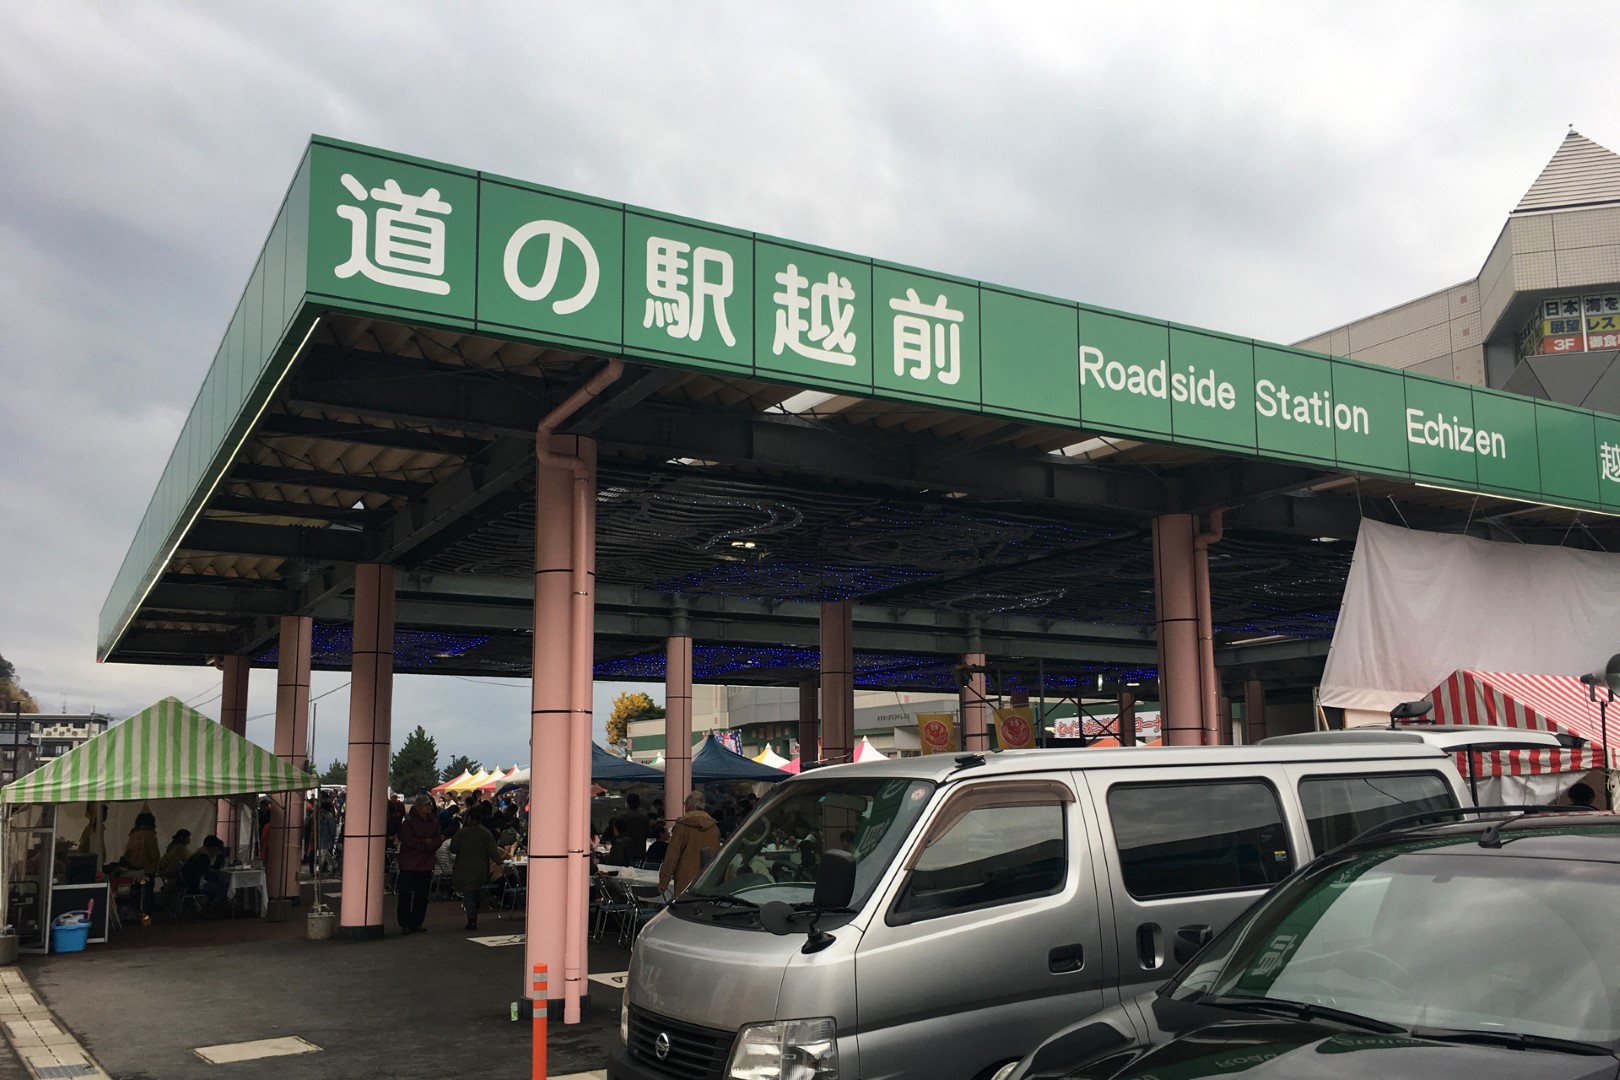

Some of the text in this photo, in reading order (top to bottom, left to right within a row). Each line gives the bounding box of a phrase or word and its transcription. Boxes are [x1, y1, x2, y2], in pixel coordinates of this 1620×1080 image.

[333, 173, 965, 386] 道の駅越前
[1545, 296, 1619, 317] 日本海を
[1553, 337, 1575, 351] 3F
[1079, 345, 1507, 459] Roadside Station Echizen
